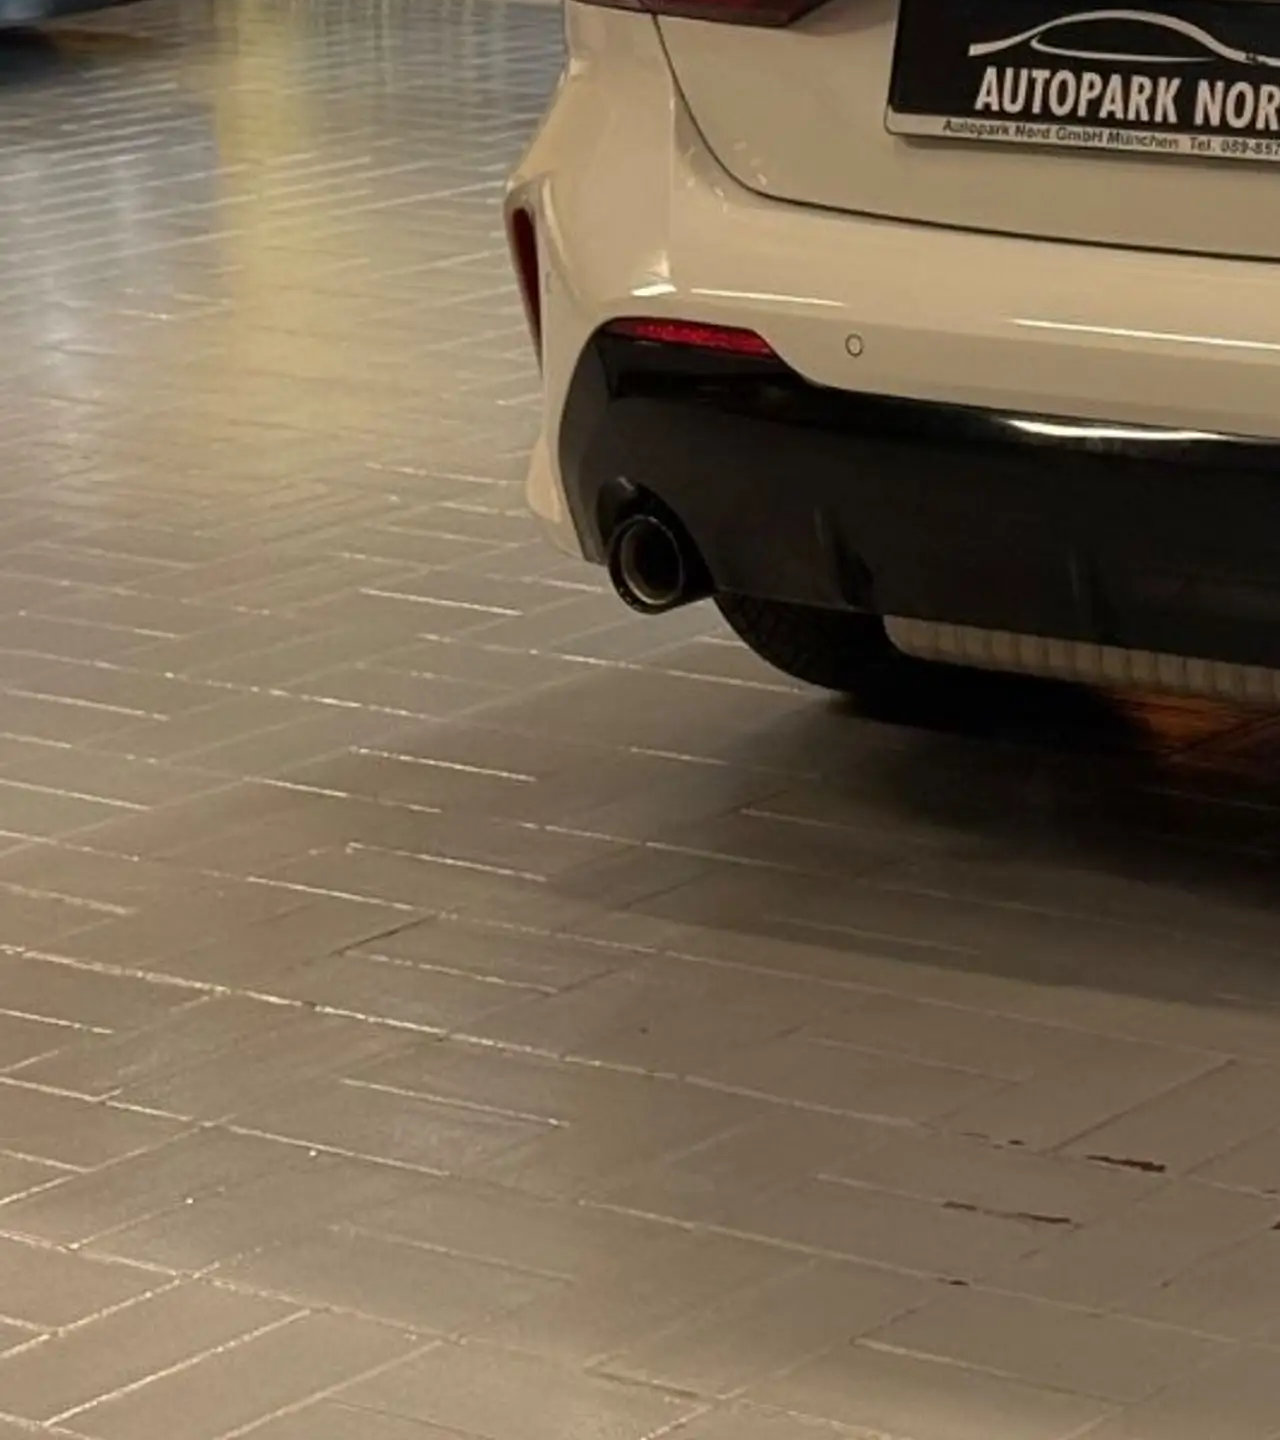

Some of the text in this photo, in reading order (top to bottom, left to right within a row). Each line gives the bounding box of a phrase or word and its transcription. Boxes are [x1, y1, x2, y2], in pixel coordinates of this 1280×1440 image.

[974, 65, 1181, 125] AUTOPARK
[942, 118, 1010, 139] Autopark
[1014, 124, 1050, 140] Nord
[1055, 126, 1103, 144] GmbH
[1106, 131, 1179, 150] München
[1189, 136, 1215, 153] Tel.
